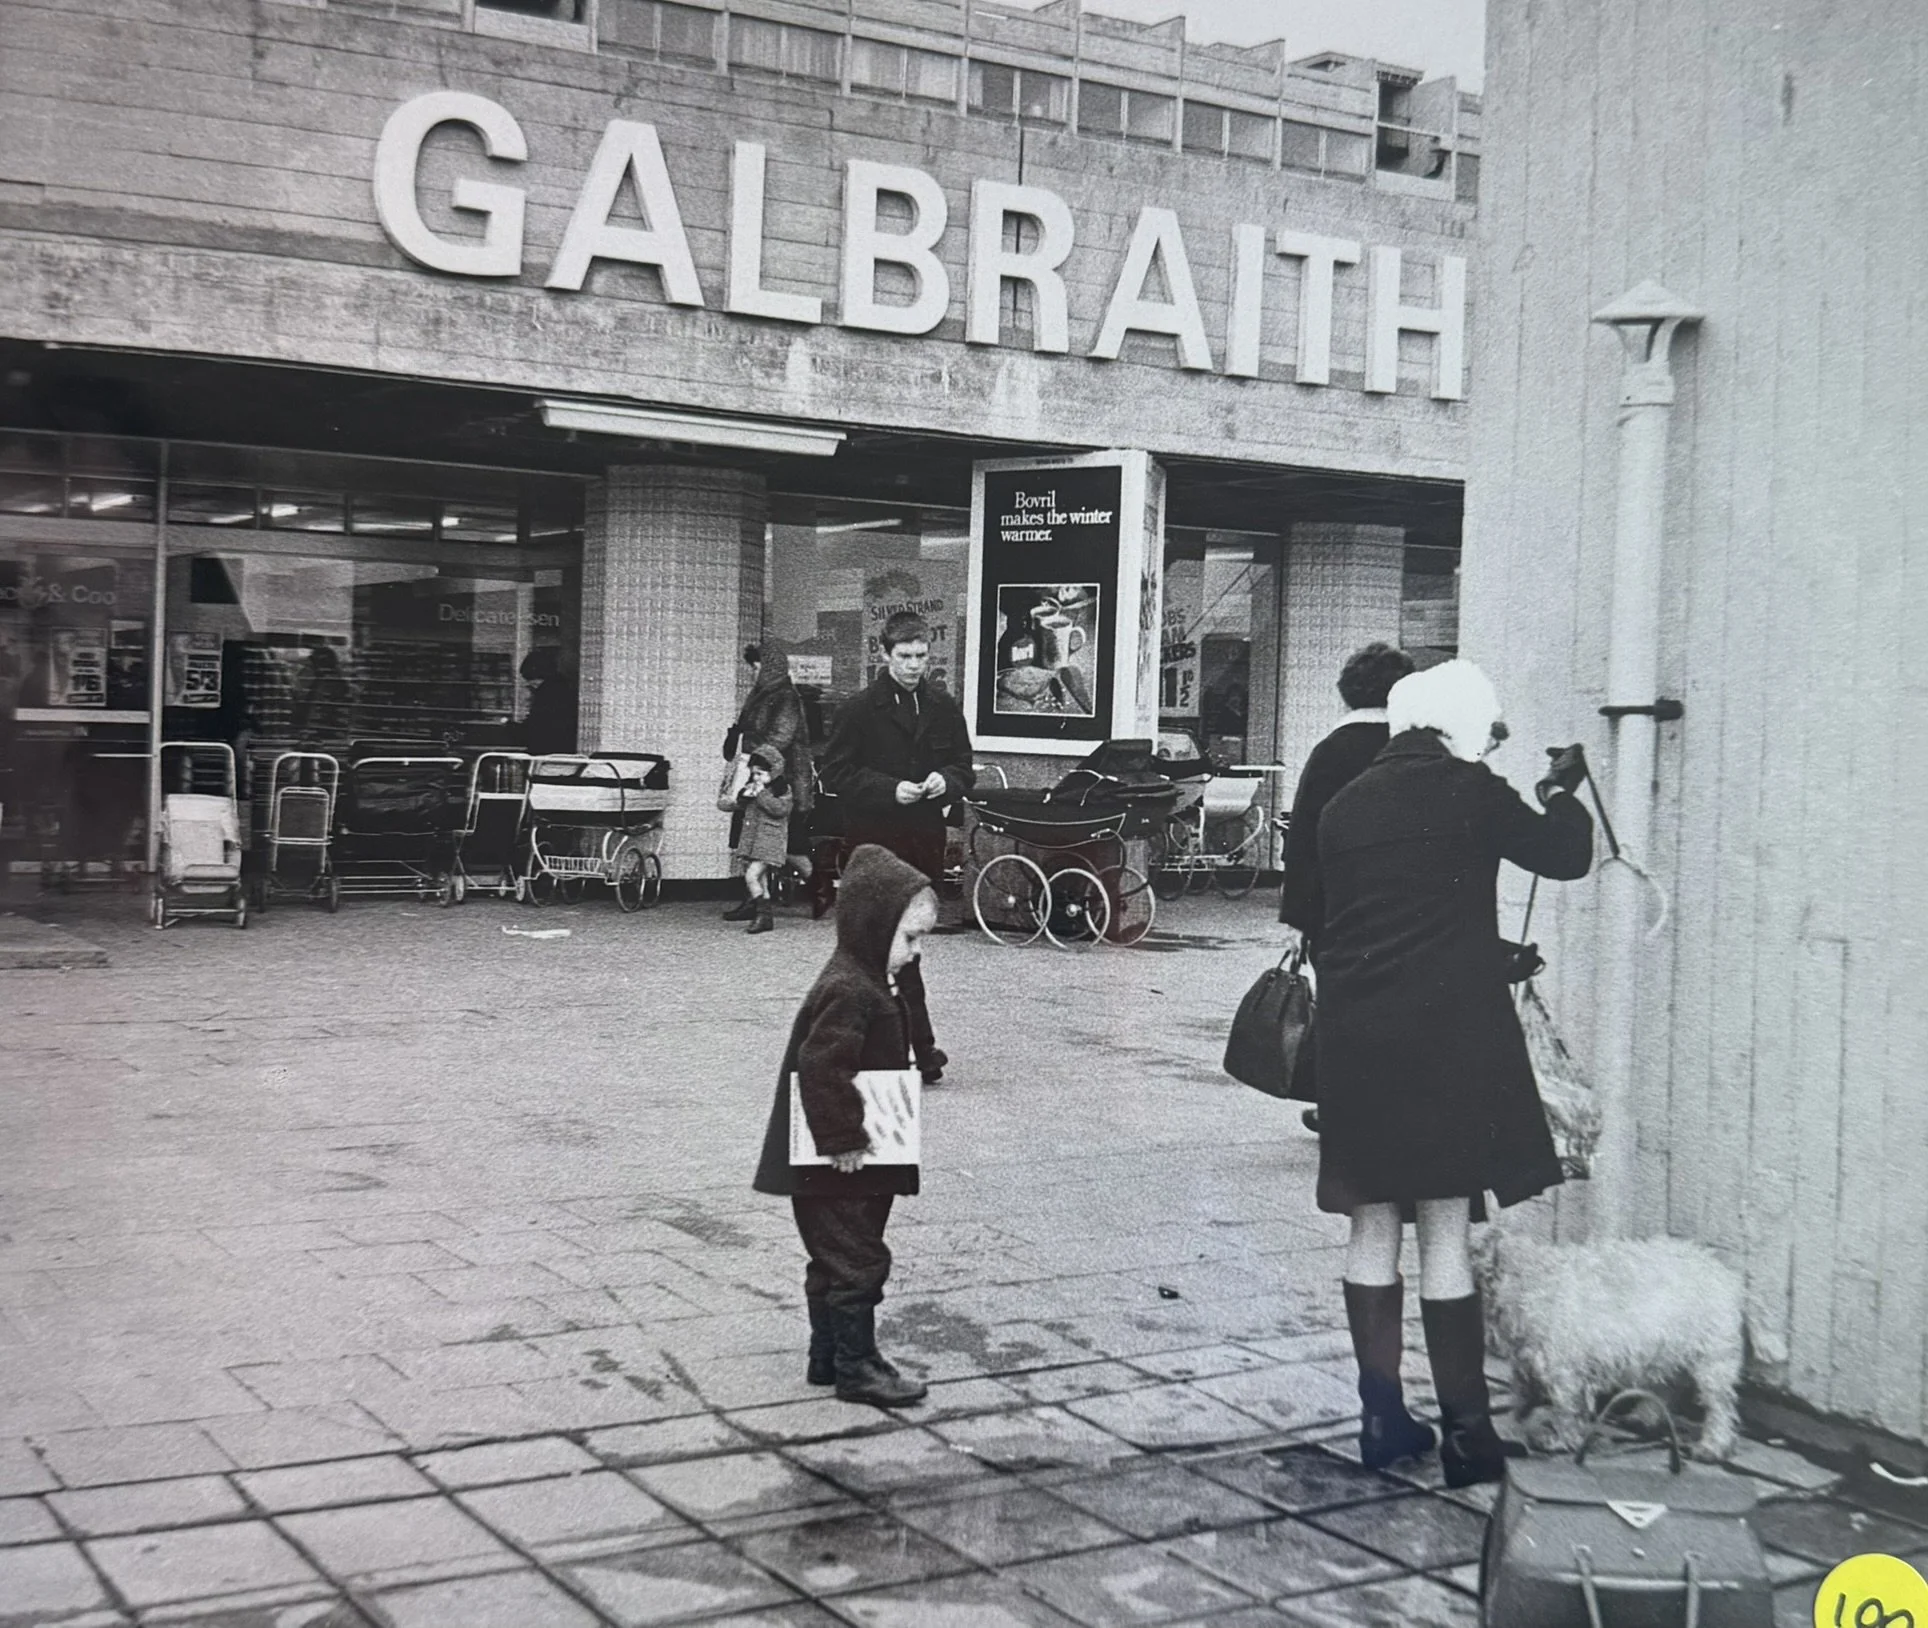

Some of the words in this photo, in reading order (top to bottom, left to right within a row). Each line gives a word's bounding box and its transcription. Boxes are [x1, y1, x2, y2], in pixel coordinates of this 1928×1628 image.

[372, 90, 1468, 402] GALBRAITH
[1014, 489, 1056, 509] Bovril
[1000, 509, 1044, 527] makes
[1046, 507, 1067, 526] the
[1068, 506, 1113, 525] winter
[1000, 528, 1053, 542] warmer.
